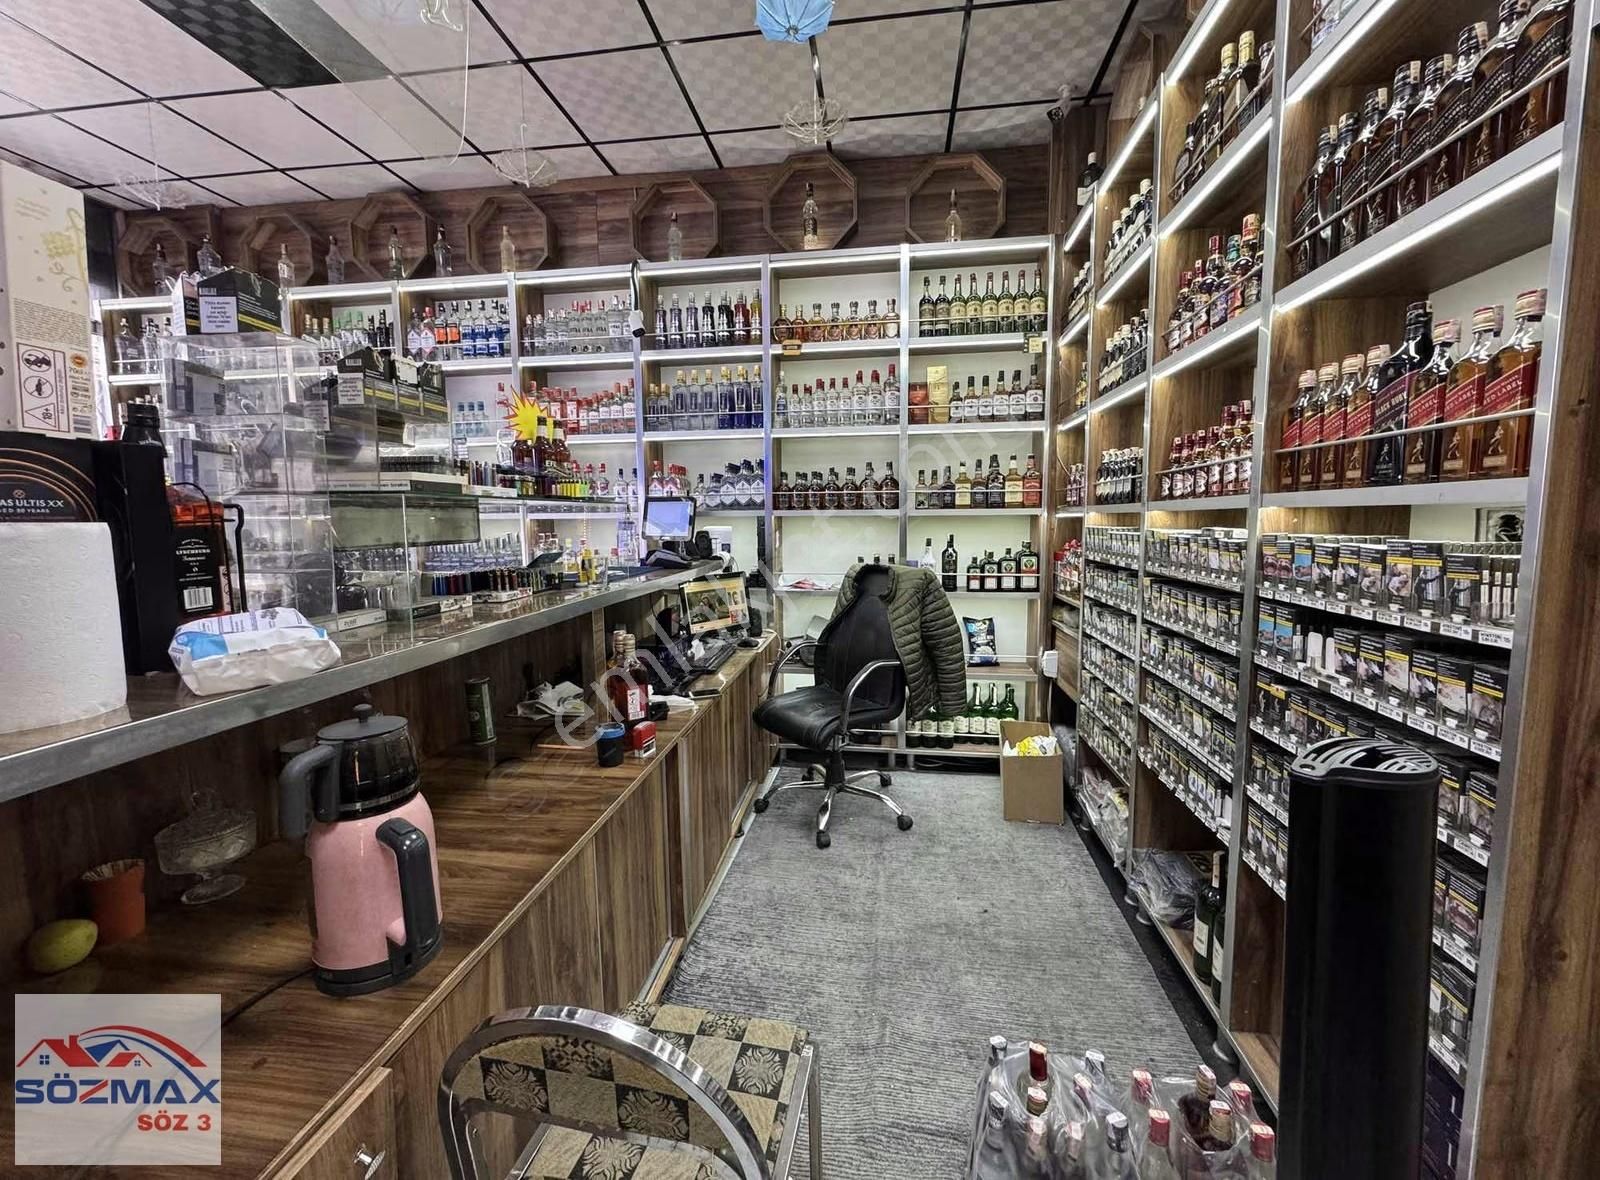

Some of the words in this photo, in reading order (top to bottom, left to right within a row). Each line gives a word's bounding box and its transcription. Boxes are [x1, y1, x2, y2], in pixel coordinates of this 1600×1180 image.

[1497, 380, 1523, 397] LABEL
[15, 499, 46, 508] ULTIS
[48, 500, 65, 508] XX
